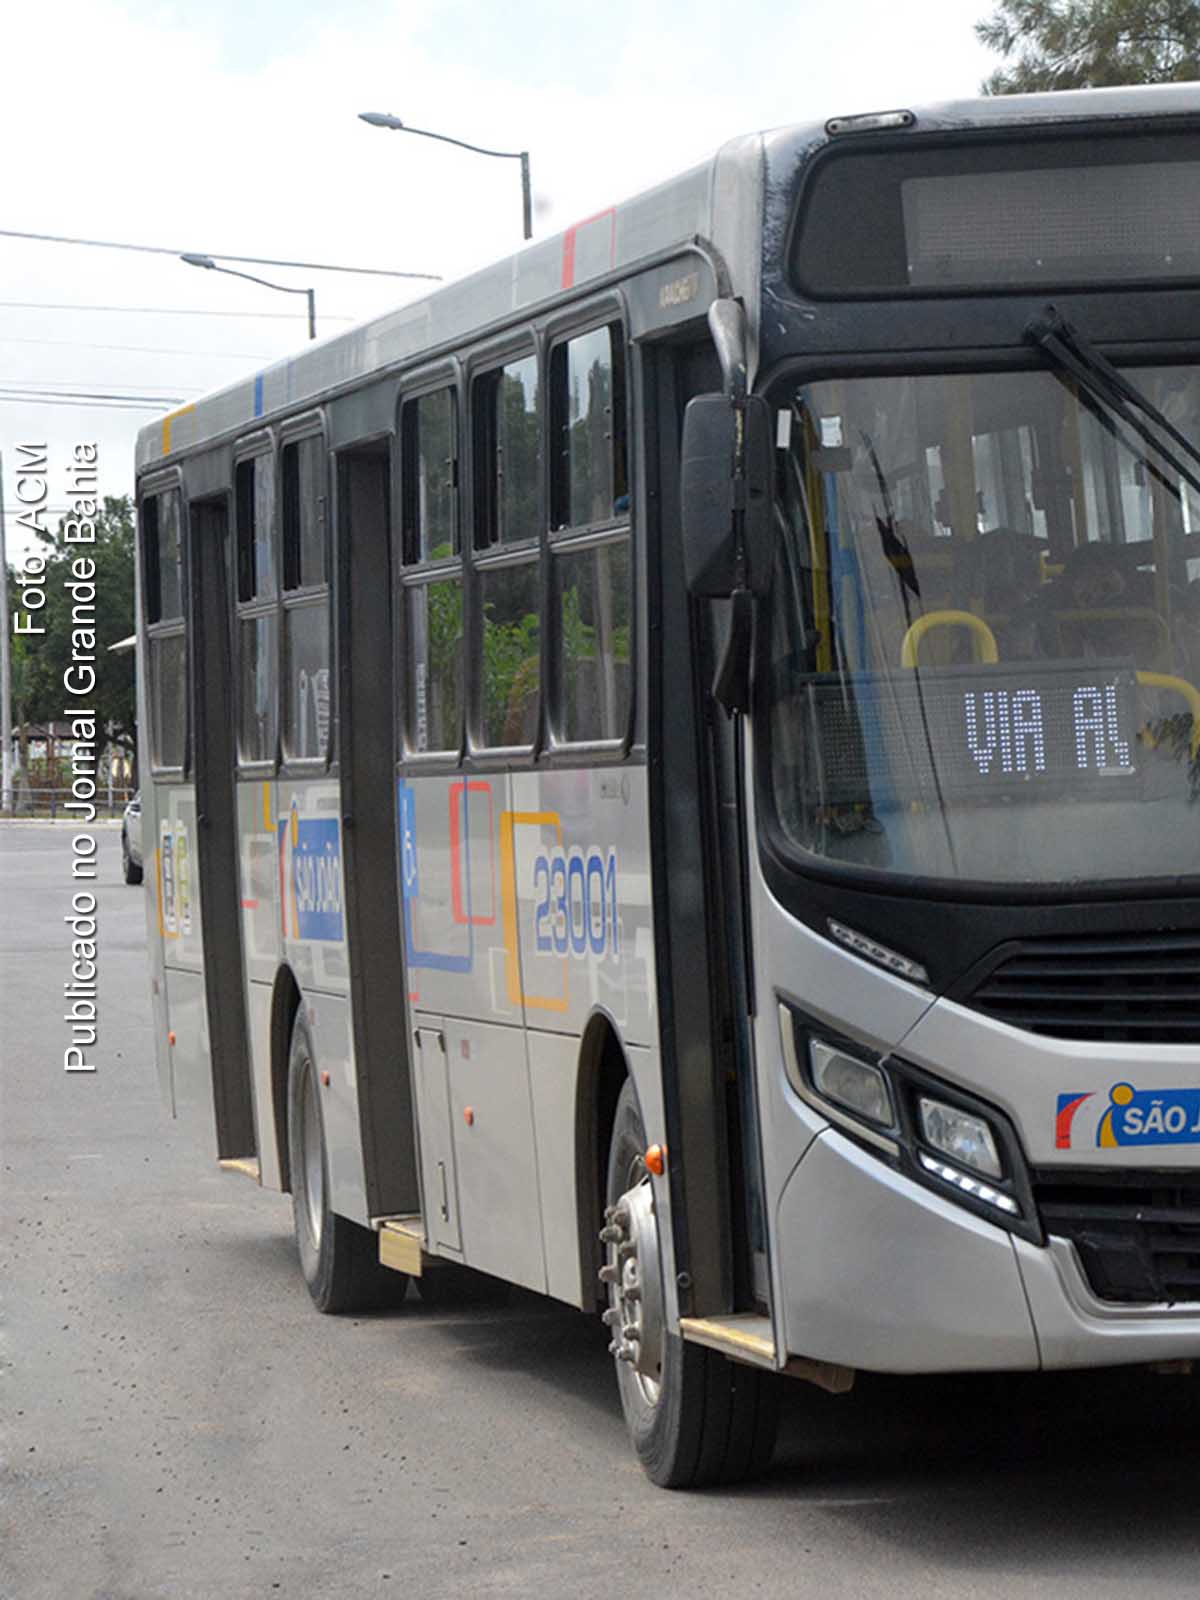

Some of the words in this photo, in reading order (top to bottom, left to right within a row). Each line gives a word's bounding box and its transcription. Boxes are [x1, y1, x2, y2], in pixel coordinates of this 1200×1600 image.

[964, 688, 1046, 774] VIA
[533, 854, 620, 956] 23001
[1122, 1099, 1188, 1135] SÃO
